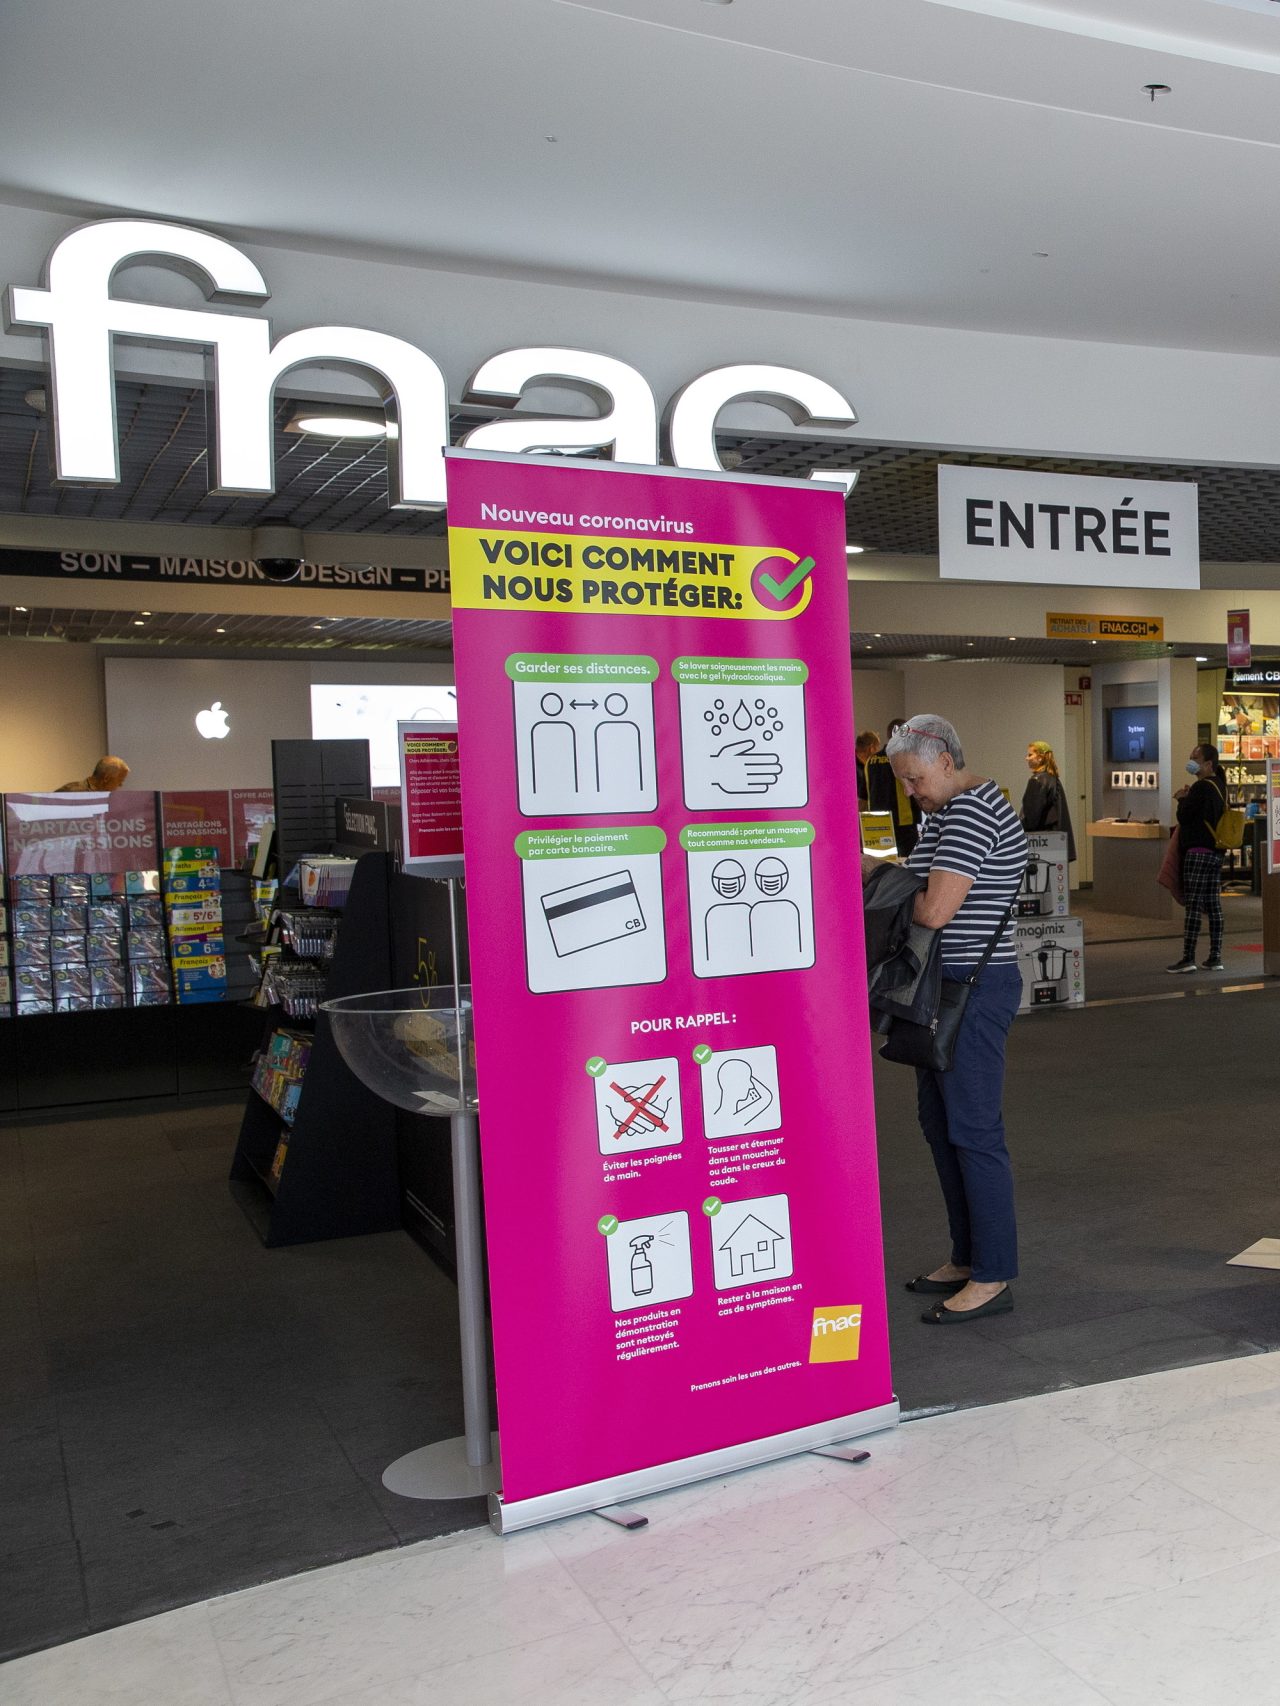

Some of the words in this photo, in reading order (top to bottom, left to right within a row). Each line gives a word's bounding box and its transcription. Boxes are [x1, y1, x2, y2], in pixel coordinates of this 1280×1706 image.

[3, 217, 860, 511] fnac
[480, 502, 574, 527] Nouveau
[579, 512, 694, 534] coronavirus
[965, 496, 1171, 557] ENTRÉE
[479, 538, 573, 568] VOICI
[582, 545, 735, 577] COMMENT
[60, 551, 122, 573] SON
[159, 556, 265, 580] MAISON
[300, 562, 392, 585] DESIGN
[482, 574, 573, 603] NOUS
[582, 578, 743, 610] PROTÉGER:
[1051, 623, 1087, 634] ACHATS
[1101, 621, 1147, 634] FNAC.CH
[515, 661, 560, 674] Garder
[563, 664, 583, 674] ses
[586, 663, 651, 675] distances.
[679, 662, 689, 670] Se
[690, 662, 709, 670] laver
[710, 662, 766, 672] soigneusement
[767, 664, 777, 672] les
[779, 664, 802, 672] mains
[1265, 671, 1280, 681] CB
[700, 672, 708, 680] le
[709, 672, 721, 682] gel
[722, 673, 786, 682] hydroalcoolique.
[19, 818, 146, 835] PARTAGEONS
[166, 820, 222, 829] PARTAGEONS
[166, 828, 184, 836] NOS
[186, 827, 228, 836] PASSIONS
[687, 828, 739, 838] Recommandé
[743, 828, 766, 837] porter
[777, 827, 808, 835] masque
[62, 835, 153, 850] PASSIONS
[528, 834, 573, 846] Privilégier
[574, 835, 582, 843] le
[584, 833, 629, 844] paiement
[706, 839, 735, 847] comme
[750, 837, 786, 845] vendeurs.
[528, 848, 544, 857] par
[546, 846, 571, 855] carte
[572, 844, 617, 854] bancaire.
[625, 918, 641, 930] CB
[1016, 923, 1065, 939] magimix
[179, 957, 209, 966] Français
[631, 1018, 673, 1034] POUR
[675, 1012, 730, 1029] RAPPEL
[707, 1144, 739, 1155] Tousser
[740, 1142, 749, 1150] et
[751, 1136, 784, 1148] éternuer
[603, 1160, 628, 1171] Éviter
[630, 1158, 642, 1167] les
[644, 1152, 682, 1166] poignées
[708, 1155, 728, 1165] dans
[730, 1154, 741, 1162] un
[742, 1147, 779, 1160] mouchoir
[709, 1168, 720, 1176] ou
[721, 1164, 741, 1174] dans
[743, 1163, 750, 1171] le
[752, 1160, 774, 1170] creux
[776, 1157, 785, 1166] du
[603, 1173, 615, 1183] de
[617, 1170, 641, 1181] main.
[710, 1176, 738, 1187] coude.
[718, 1294, 744, 1306] Rester
[745, 1292, 750, 1300] à
[752, 1290, 760, 1299] la
[761, 1285, 790, 1297] maison
[793, 1282, 802, 1291] en
[718, 1308, 732, 1316] cas
[734, 1304, 744, 1313] de
[746, 1295, 794, 1311] symptômes.
[615, 1318, 631, 1328] Nos
[633, 1310, 669, 1325] produits
[670, 1308, 681, 1316] en
[813, 1313, 862, 1337] fnac
[615, 1320, 679, 1339] démonstration
[616, 1340, 635, 1350] sont
[636, 1330, 675, 1346] nettoyés
[616, 1340, 680, 1361] régulièrement.
[691, 1379, 720, 1392] Prenons
[722, 1375, 737, 1384] soin
[738, 1372, 749, 1381] les
[750, 1369, 762, 1378] uns
[763, 1366, 776, 1375] des
[777, 1360, 802, 1372] autres.
